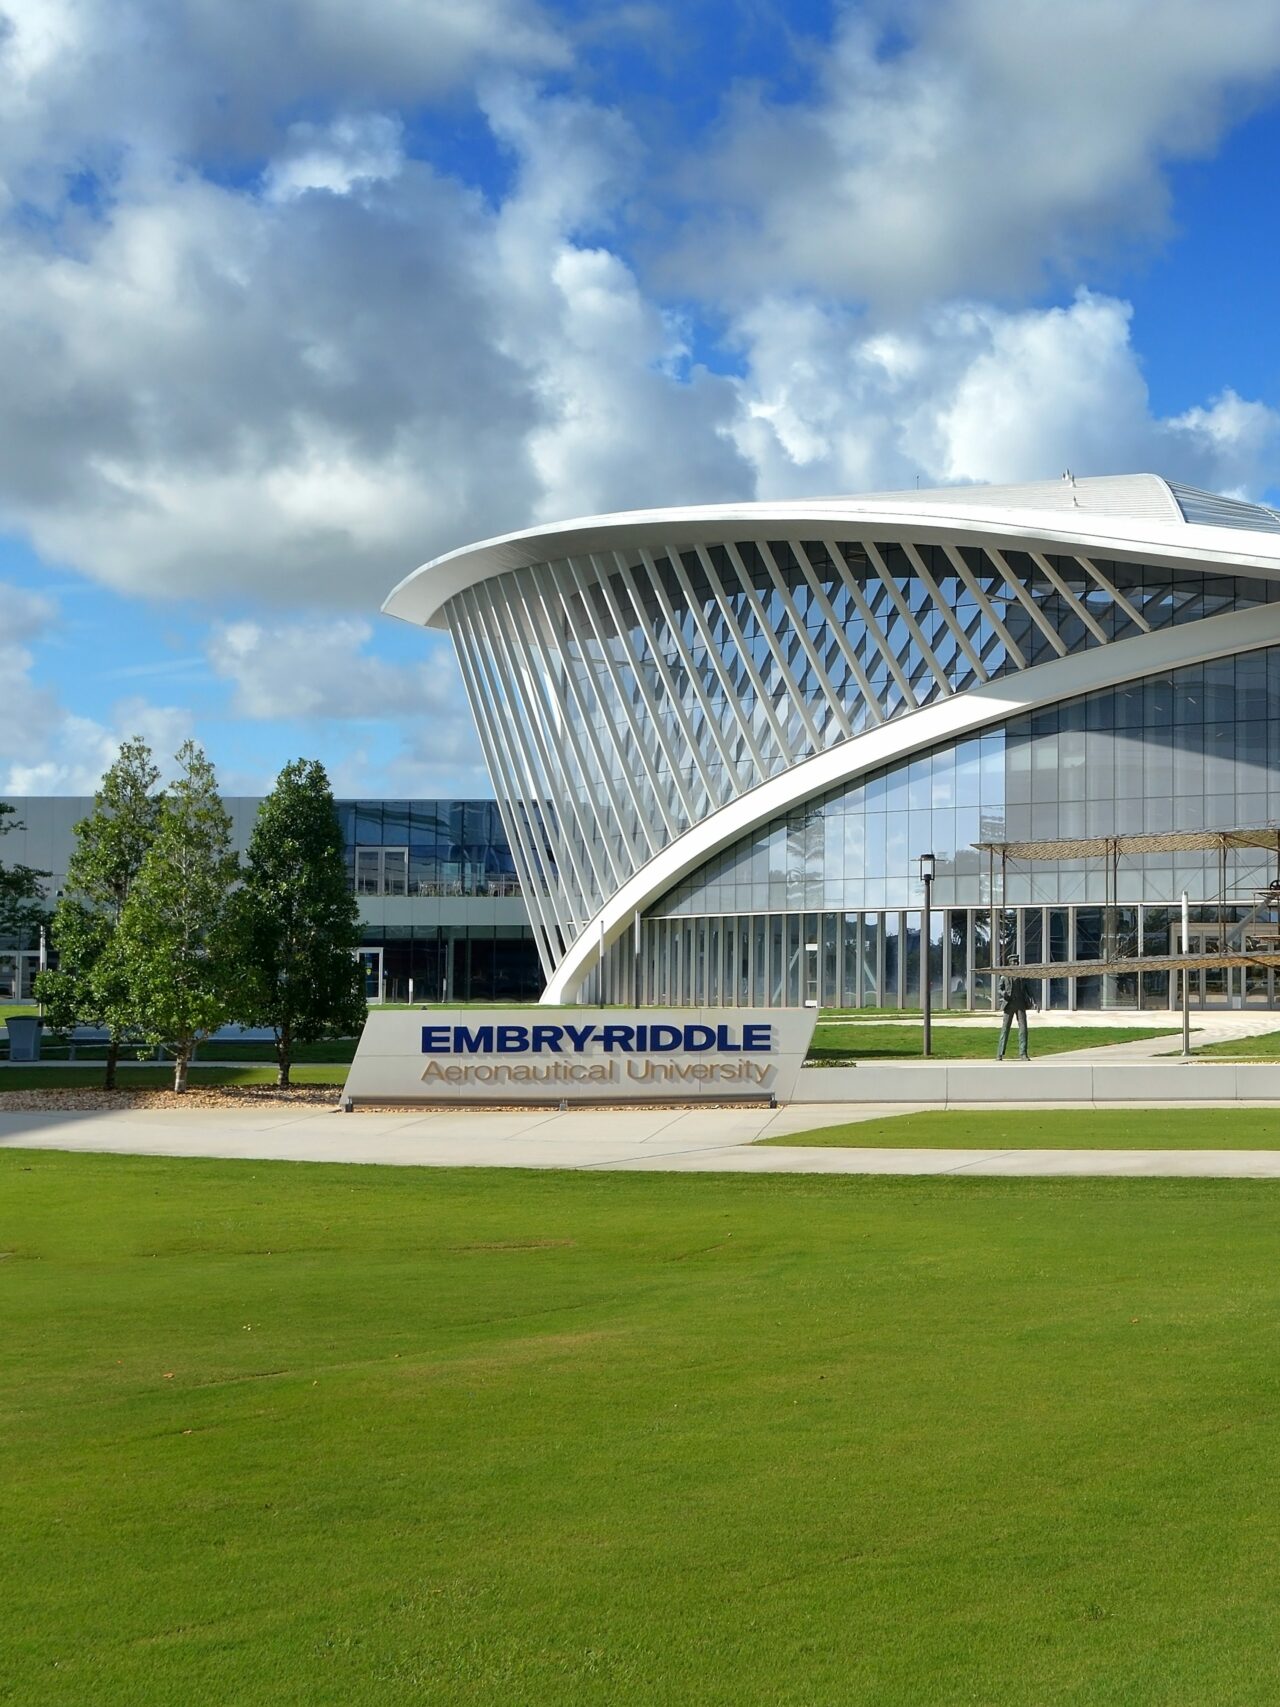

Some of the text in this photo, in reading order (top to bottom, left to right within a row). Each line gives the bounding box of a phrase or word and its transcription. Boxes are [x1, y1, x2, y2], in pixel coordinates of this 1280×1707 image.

[421, 1024, 772, 1053] EMBRY-RIDDLE
[421, 1059, 771, 1084] Aeronautical University
